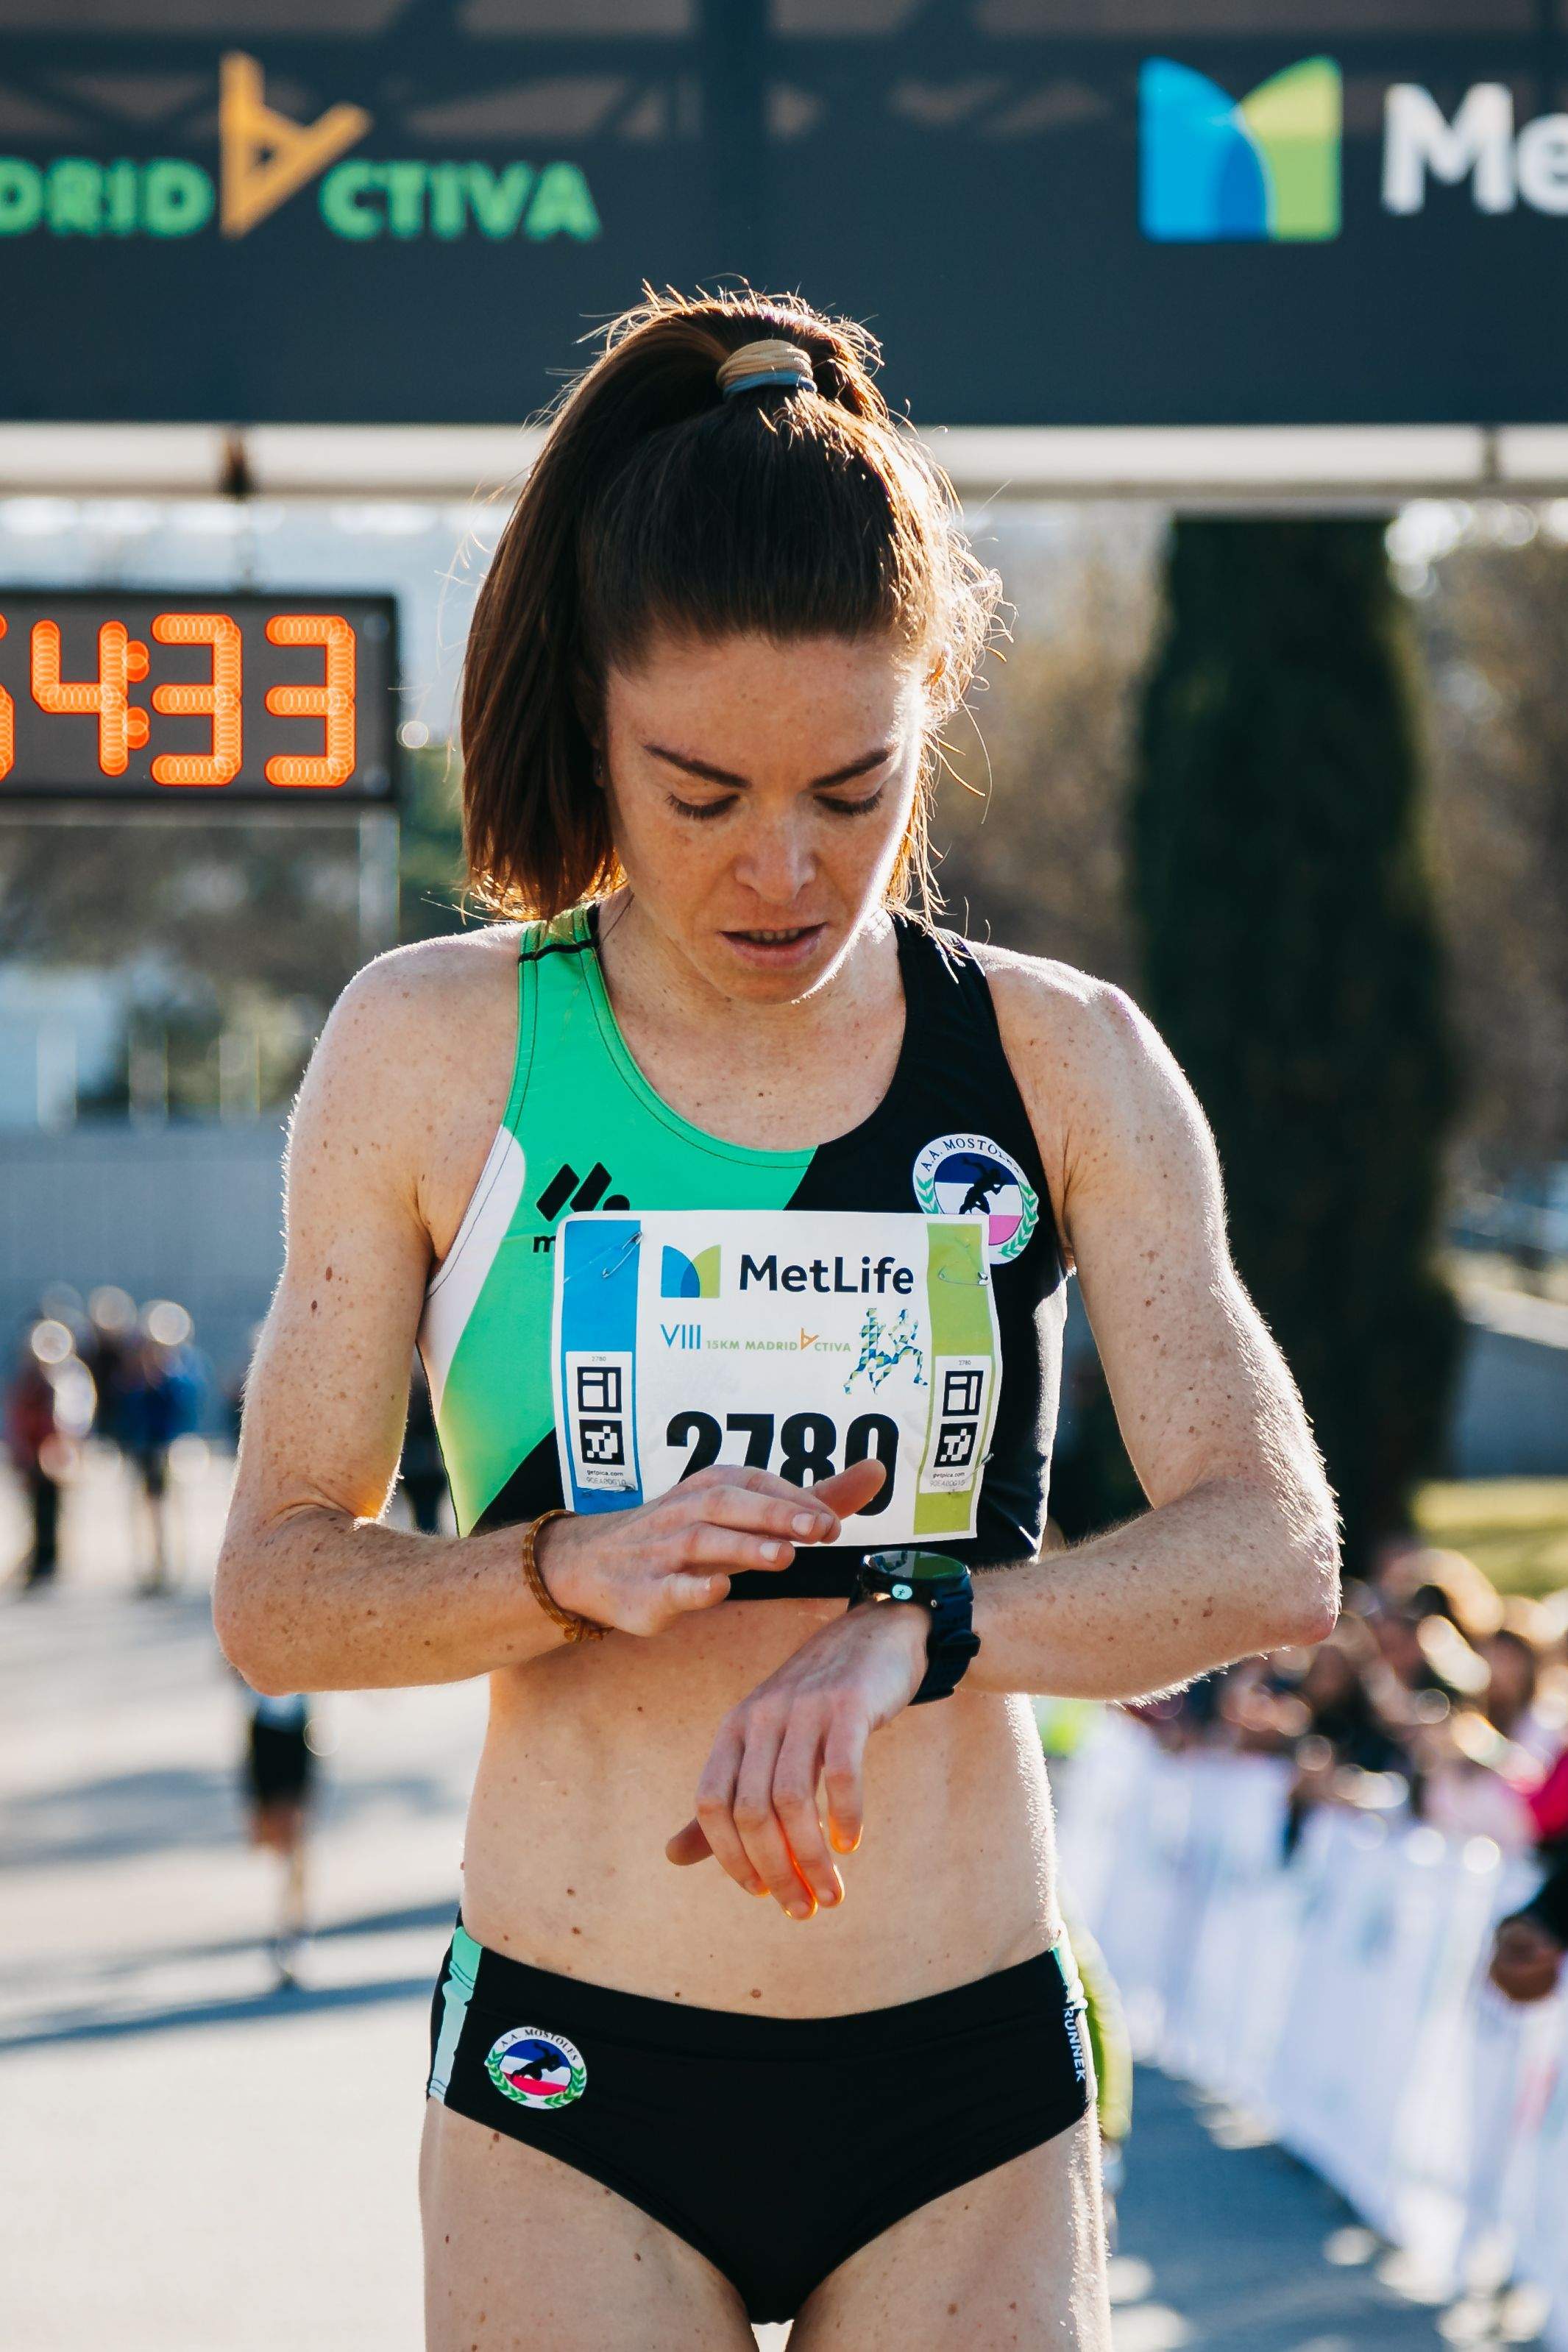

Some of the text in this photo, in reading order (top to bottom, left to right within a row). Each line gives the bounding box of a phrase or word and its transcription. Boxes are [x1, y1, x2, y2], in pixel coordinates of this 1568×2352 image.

[1380, 82, 1568, 216] Me
[0, 613, 356, 787] 4:33
[943, 1138, 1020, 1173] MOSTO
[739, 1253, 914, 1294] MetLife
[660, 1324, 701, 1350] VIII
[706, 1340, 739, 1350] 15KM
[745, 1340, 797, 1351] MADRID
